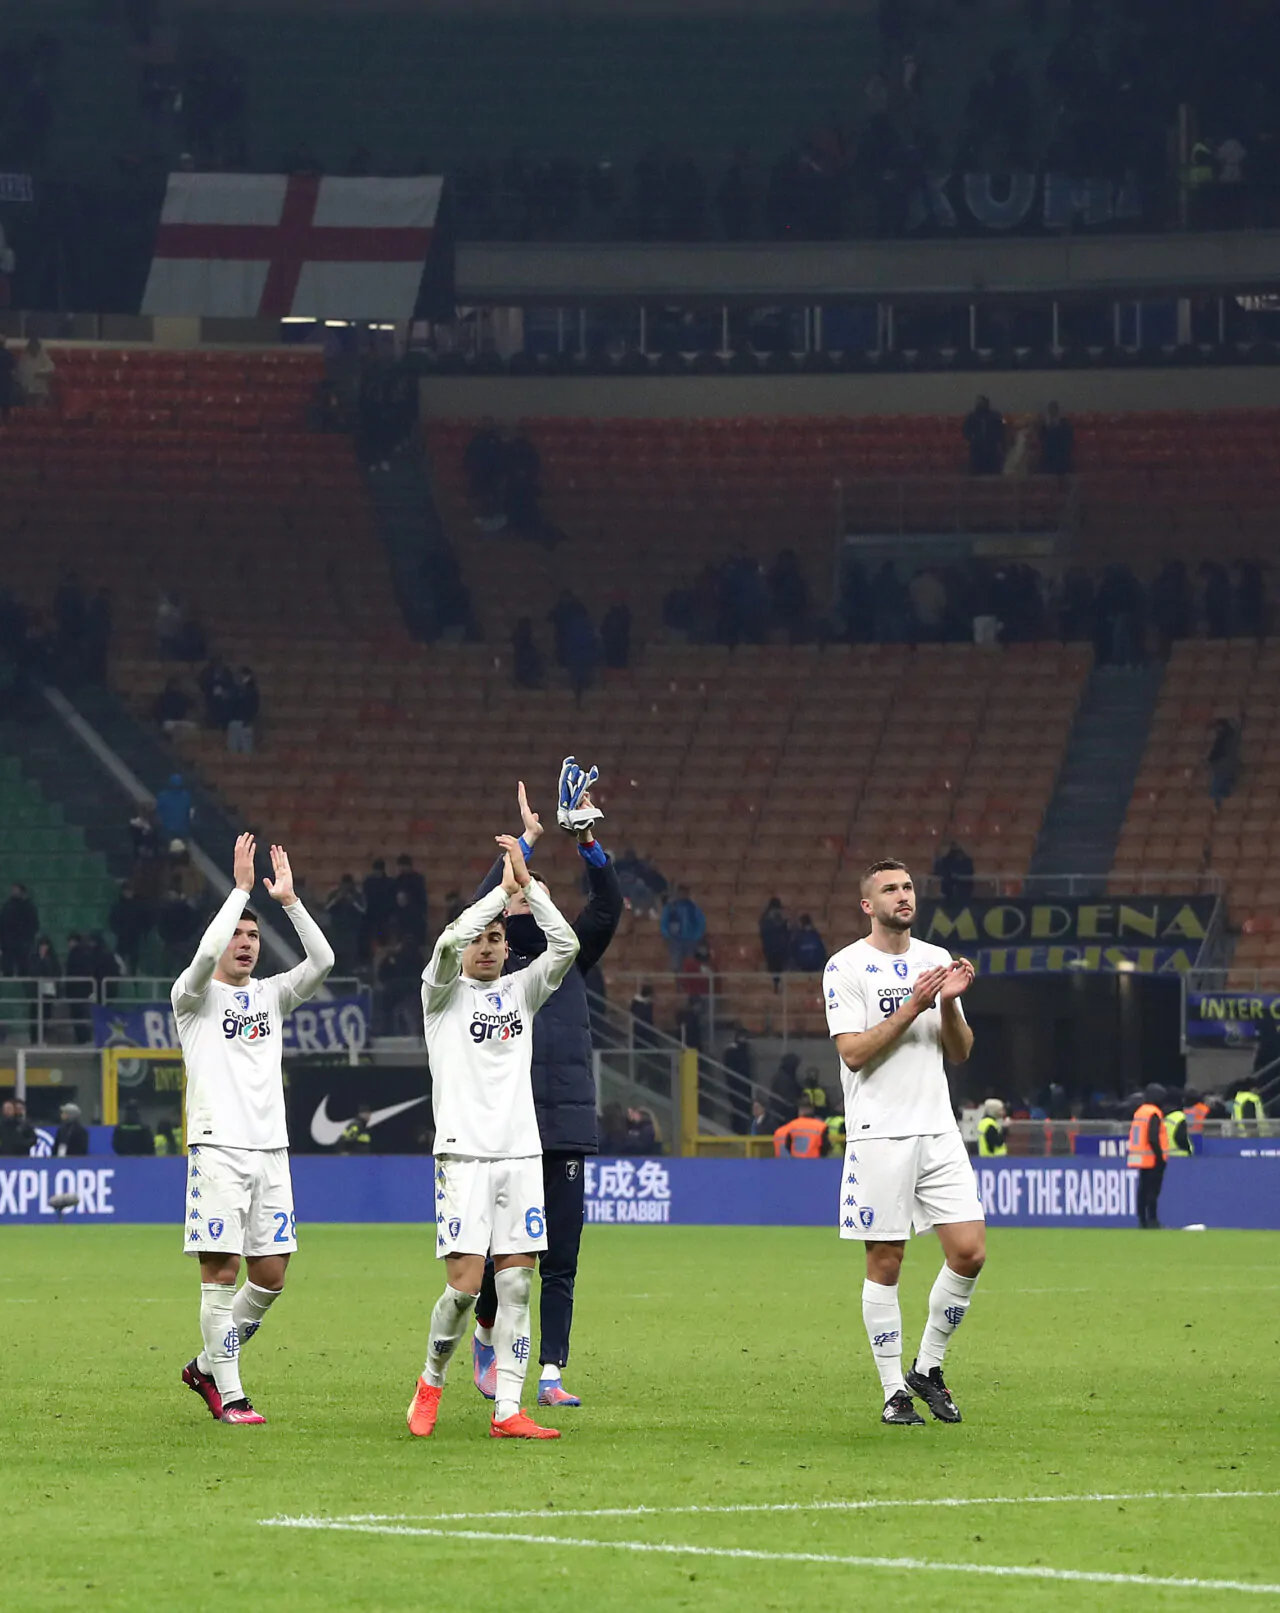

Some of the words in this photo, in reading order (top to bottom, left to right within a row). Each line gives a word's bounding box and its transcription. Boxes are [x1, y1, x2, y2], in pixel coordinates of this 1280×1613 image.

[925, 903, 1209, 941] MODENA
[877, 986, 914, 998] compu
[1200, 997, 1264, 1020] INTER
[222, 1017, 271, 1040] gross
[468, 1018, 524, 1044] gross
[997, 1169, 1022, 1216] OF
[1024, 1169, 1063, 1216] THE
[1064, 1168, 1139, 1216] RABBIT
[616, 1200, 671, 1222] RABBIT
